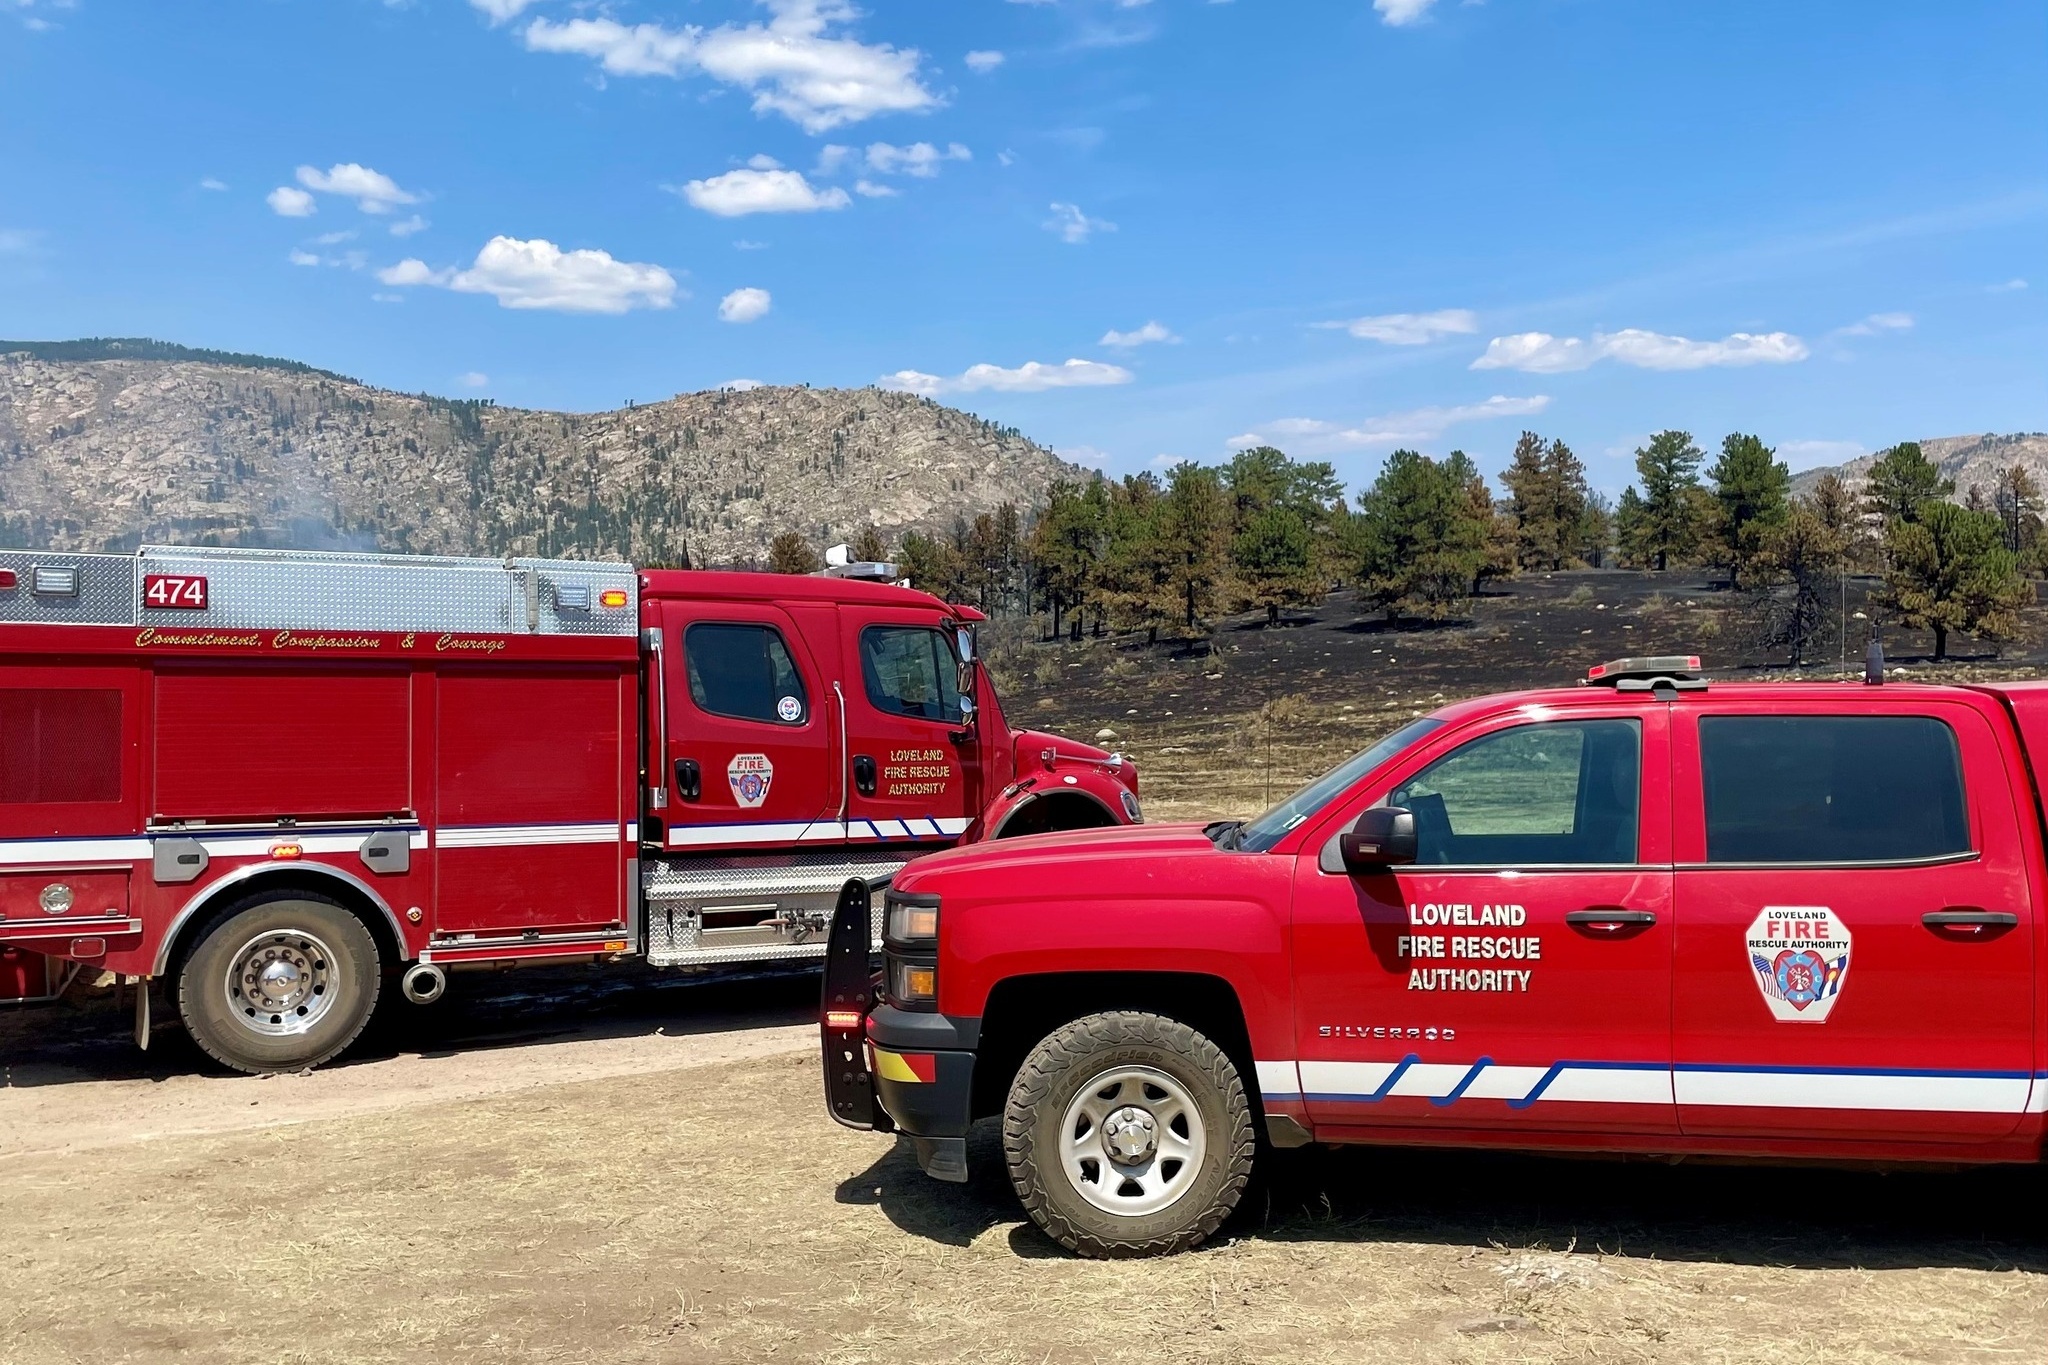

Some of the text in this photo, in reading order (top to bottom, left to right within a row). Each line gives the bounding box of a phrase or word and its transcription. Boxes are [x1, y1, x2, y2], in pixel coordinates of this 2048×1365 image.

[148, 579, 203, 605] 474
[135, 627, 506, 655] Commitment, Compassion & Courage
[890, 749, 944, 762] LOVELAND
[737, 760, 764, 769] FIRE
[884, 765, 950, 779] FIRE RESCUE
[888, 782, 946, 796] AUTHORITY
[1410, 903, 1527, 927] LOVELAND
[1768, 911, 1827, 920] LOVELAND
[1767, 921, 1829, 939] FIRE
[1398, 935, 1541, 960] FIRE RESCUE
[1749, 940, 1849, 949] RESCUE AUTHORITY
[1407, 968, 1532, 992] AUTHORITY
[1319, 1026, 1455, 1040] SILVERADO
